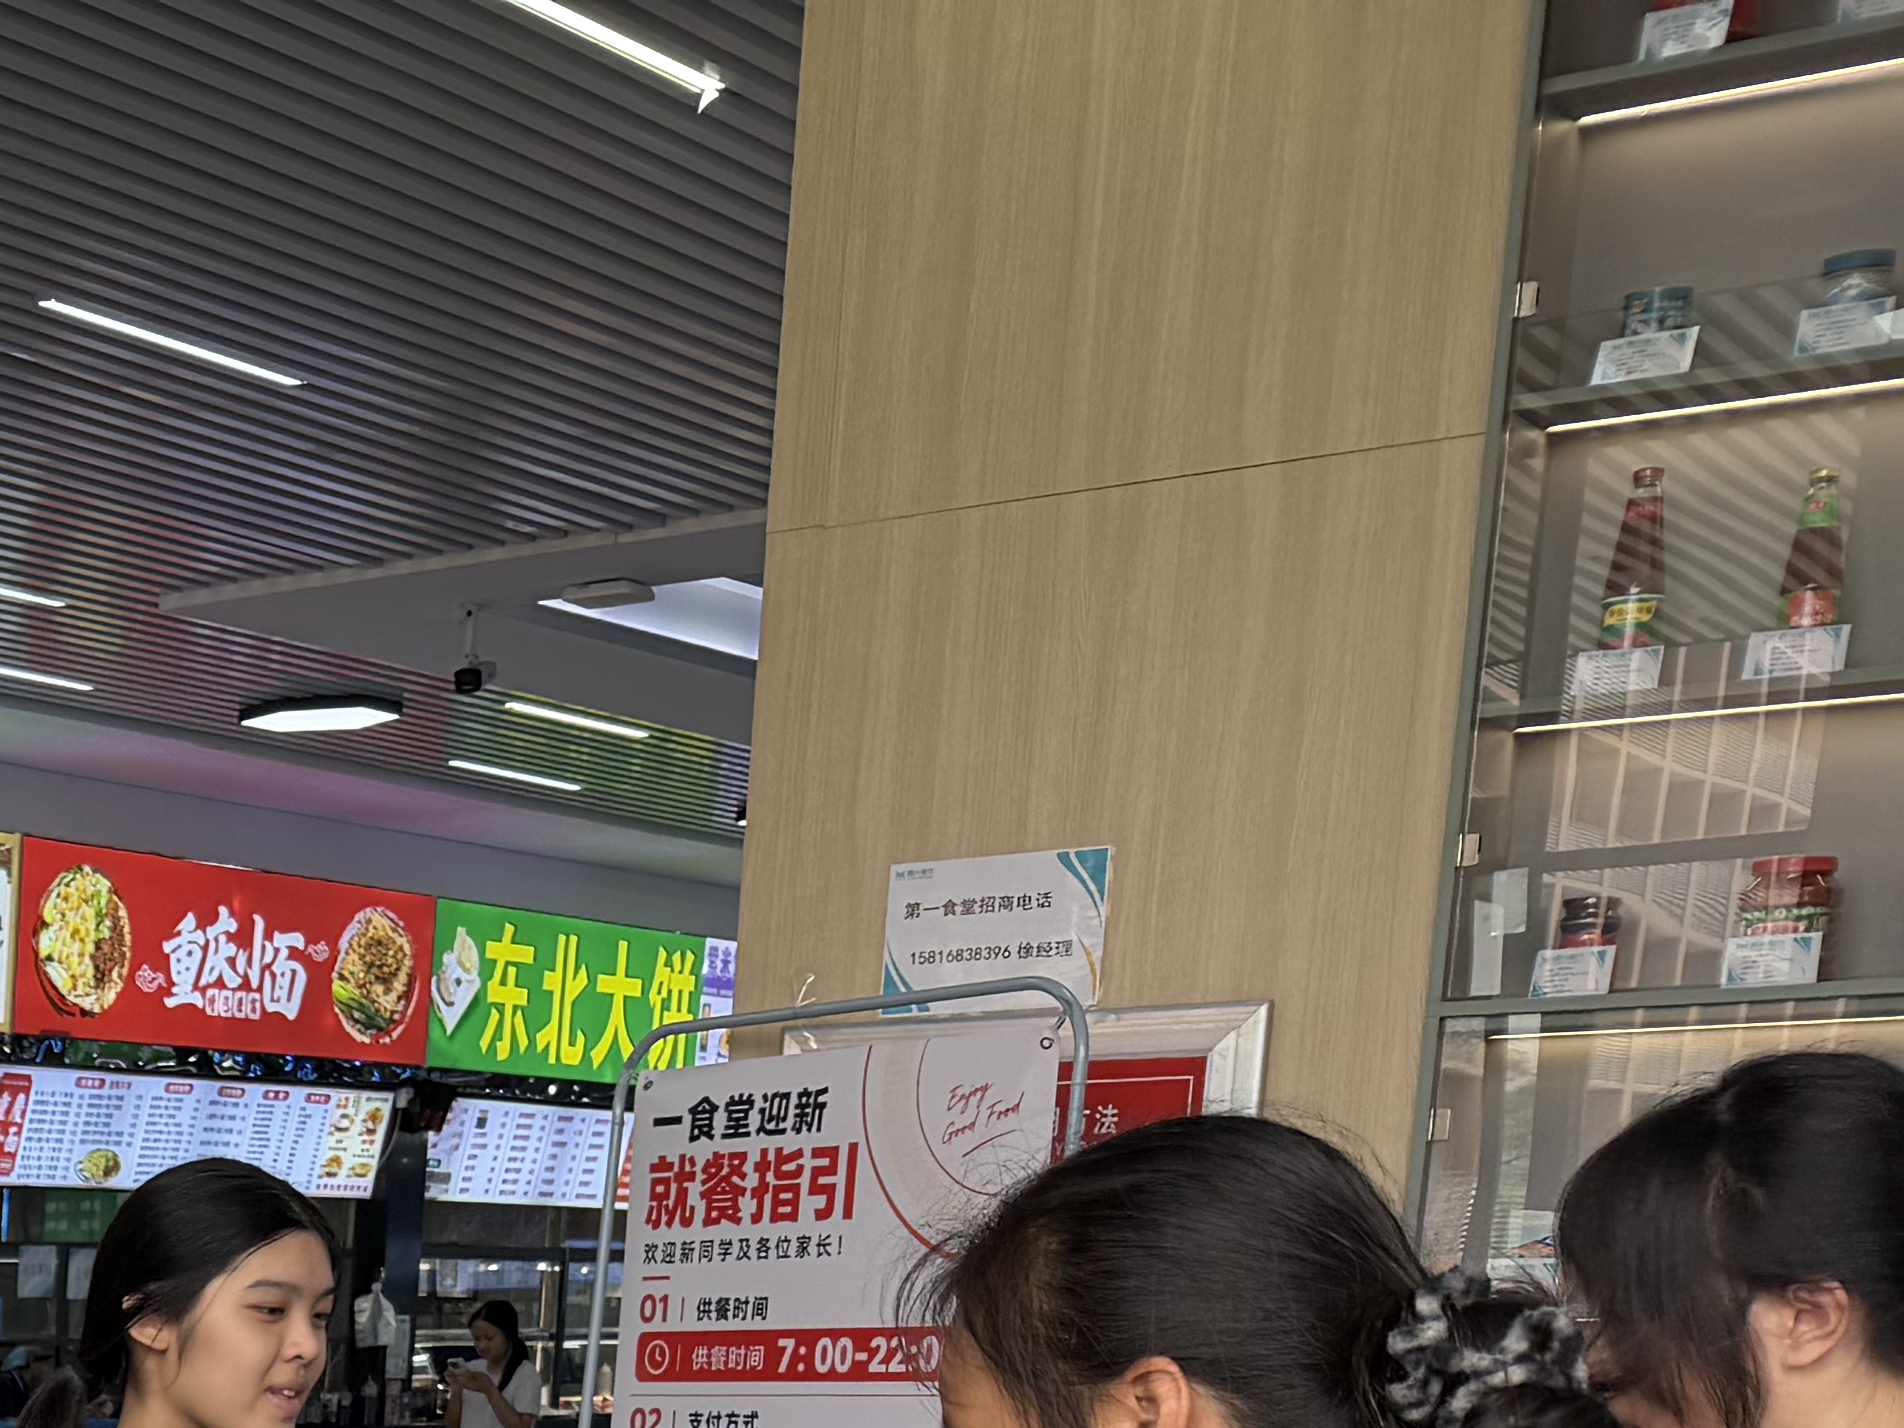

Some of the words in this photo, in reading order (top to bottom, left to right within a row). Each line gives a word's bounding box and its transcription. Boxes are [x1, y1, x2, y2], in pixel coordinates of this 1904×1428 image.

[904, 891, 1053, 920] 第一食堂招商电话
[162, 905, 307, 1021] 重庆小面
[910, 944, 1012, 966] 15816838396
[1017, 939, 1073, 960] 徐经理
[479, 922, 696, 1071] 东北大饼
[947, 1079, 995, 1114] Enjoy
[653, 1085, 830, 1144] 一食堂迎新
[942, 1112, 983, 1146] Good
[985, 1092, 1025, 1129] Food
[644, 1142, 860, 1231] 就餐指引
[643, 1234, 844, 1267] 欢迎新同学及各位家长！
[639, 1293, 670, 1325] 01
[696, 1295, 769, 1323] 供餐时间
[692, 1345, 765, 1373] 供餐时间
